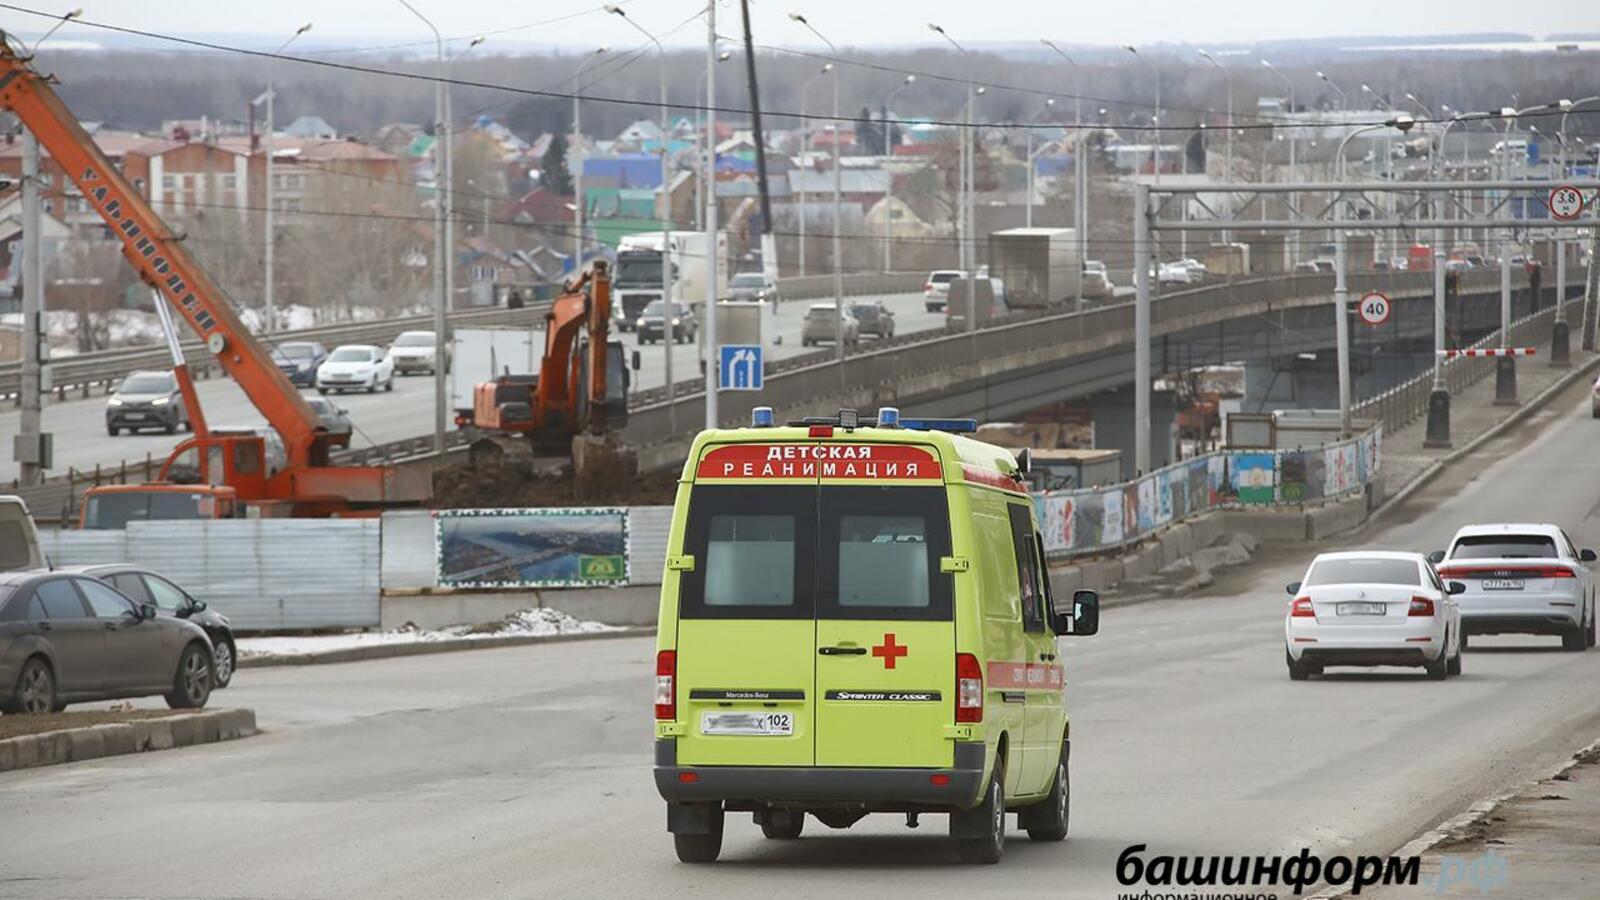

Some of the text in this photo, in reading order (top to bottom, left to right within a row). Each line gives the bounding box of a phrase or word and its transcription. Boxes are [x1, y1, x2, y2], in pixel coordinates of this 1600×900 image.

[1366, 302, 1385, 315] 40
[767, 446, 872, 461] ДЕТСКАЯ
[724, 463, 918, 478] РЕАНИМАЦИЯ
[767, 714, 789, 727] 102
